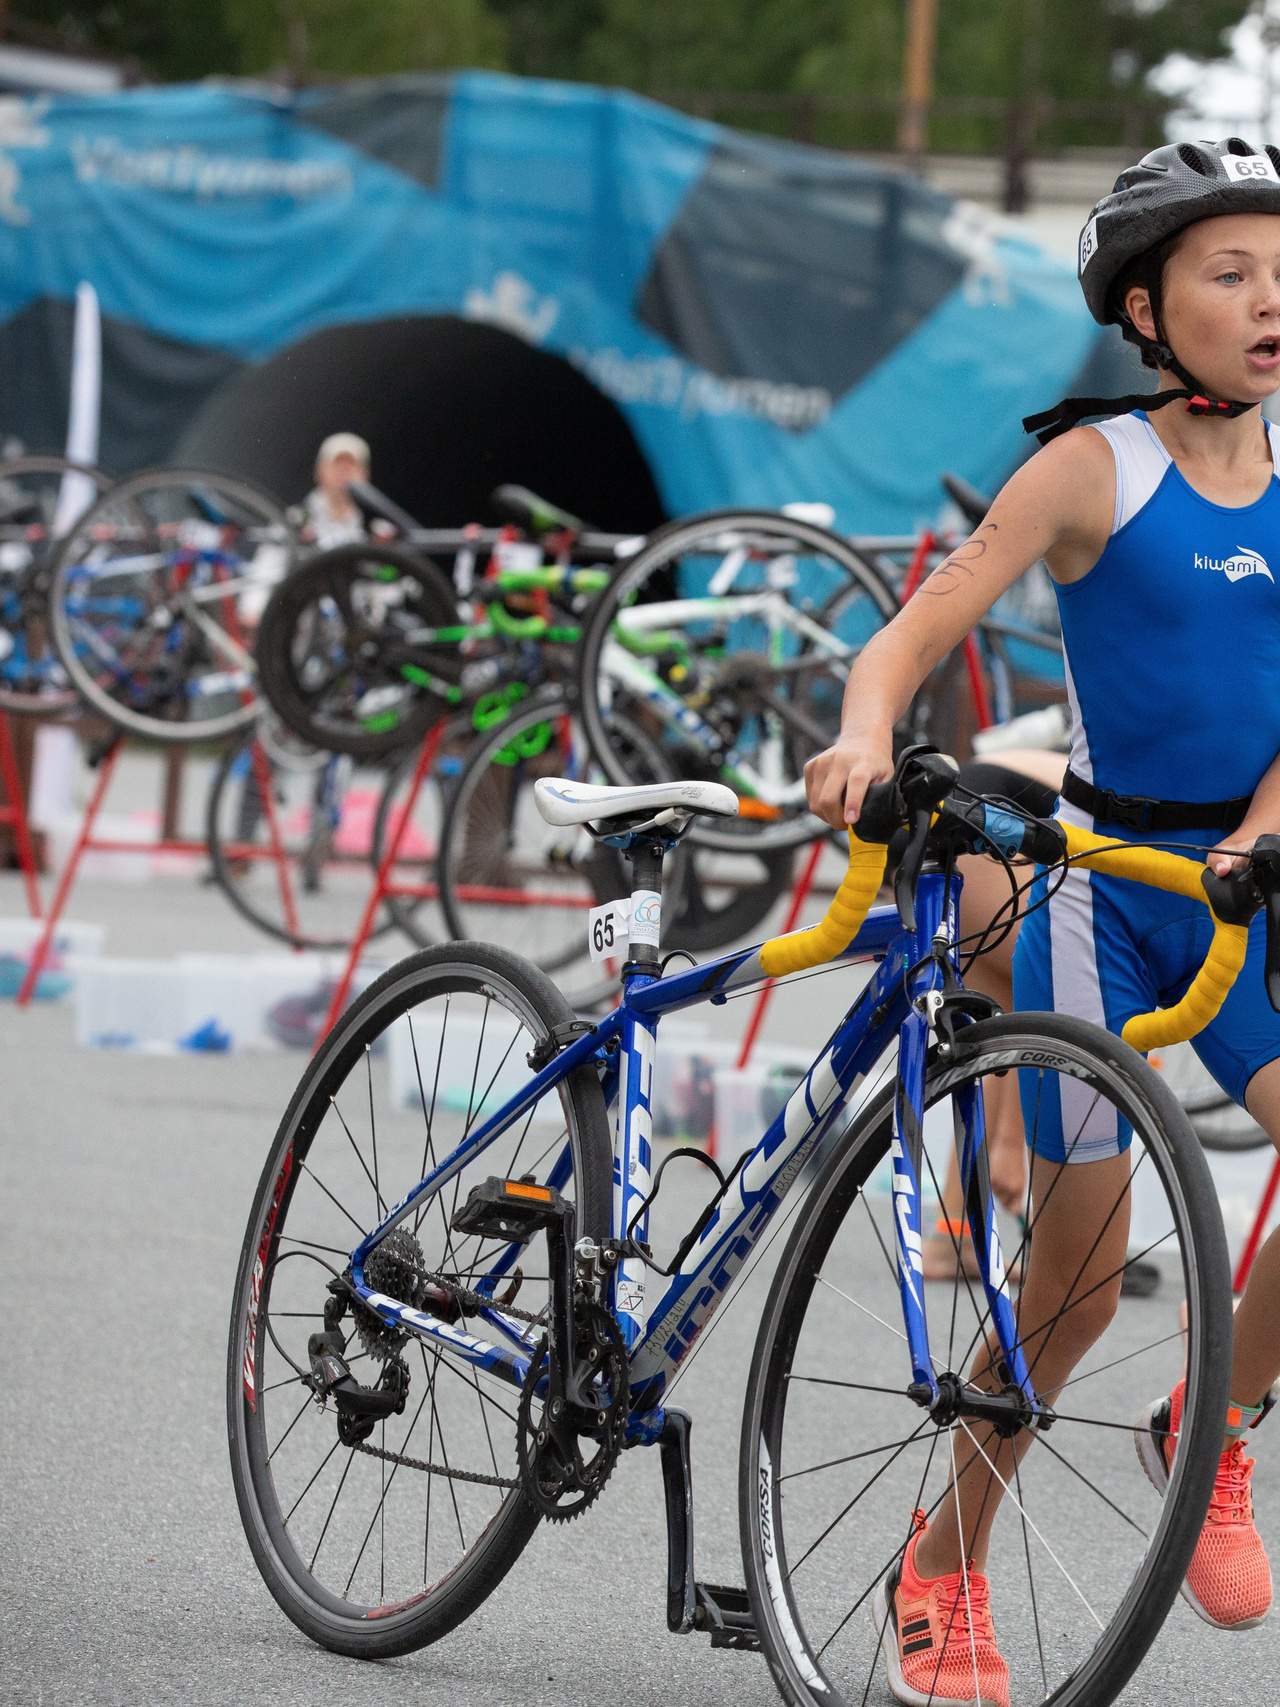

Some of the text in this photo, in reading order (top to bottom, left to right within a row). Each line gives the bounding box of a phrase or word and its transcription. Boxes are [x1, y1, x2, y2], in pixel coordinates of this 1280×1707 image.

[1234, 161, 1269, 177] 65
[1081, 232, 1093, 264] 65
[1194, 552, 1257, 574] kiwami
[593, 912, 615, 953] 65
[367, 1293, 496, 1353] FUJI
[759, 1467, 774, 1558] CORSA
